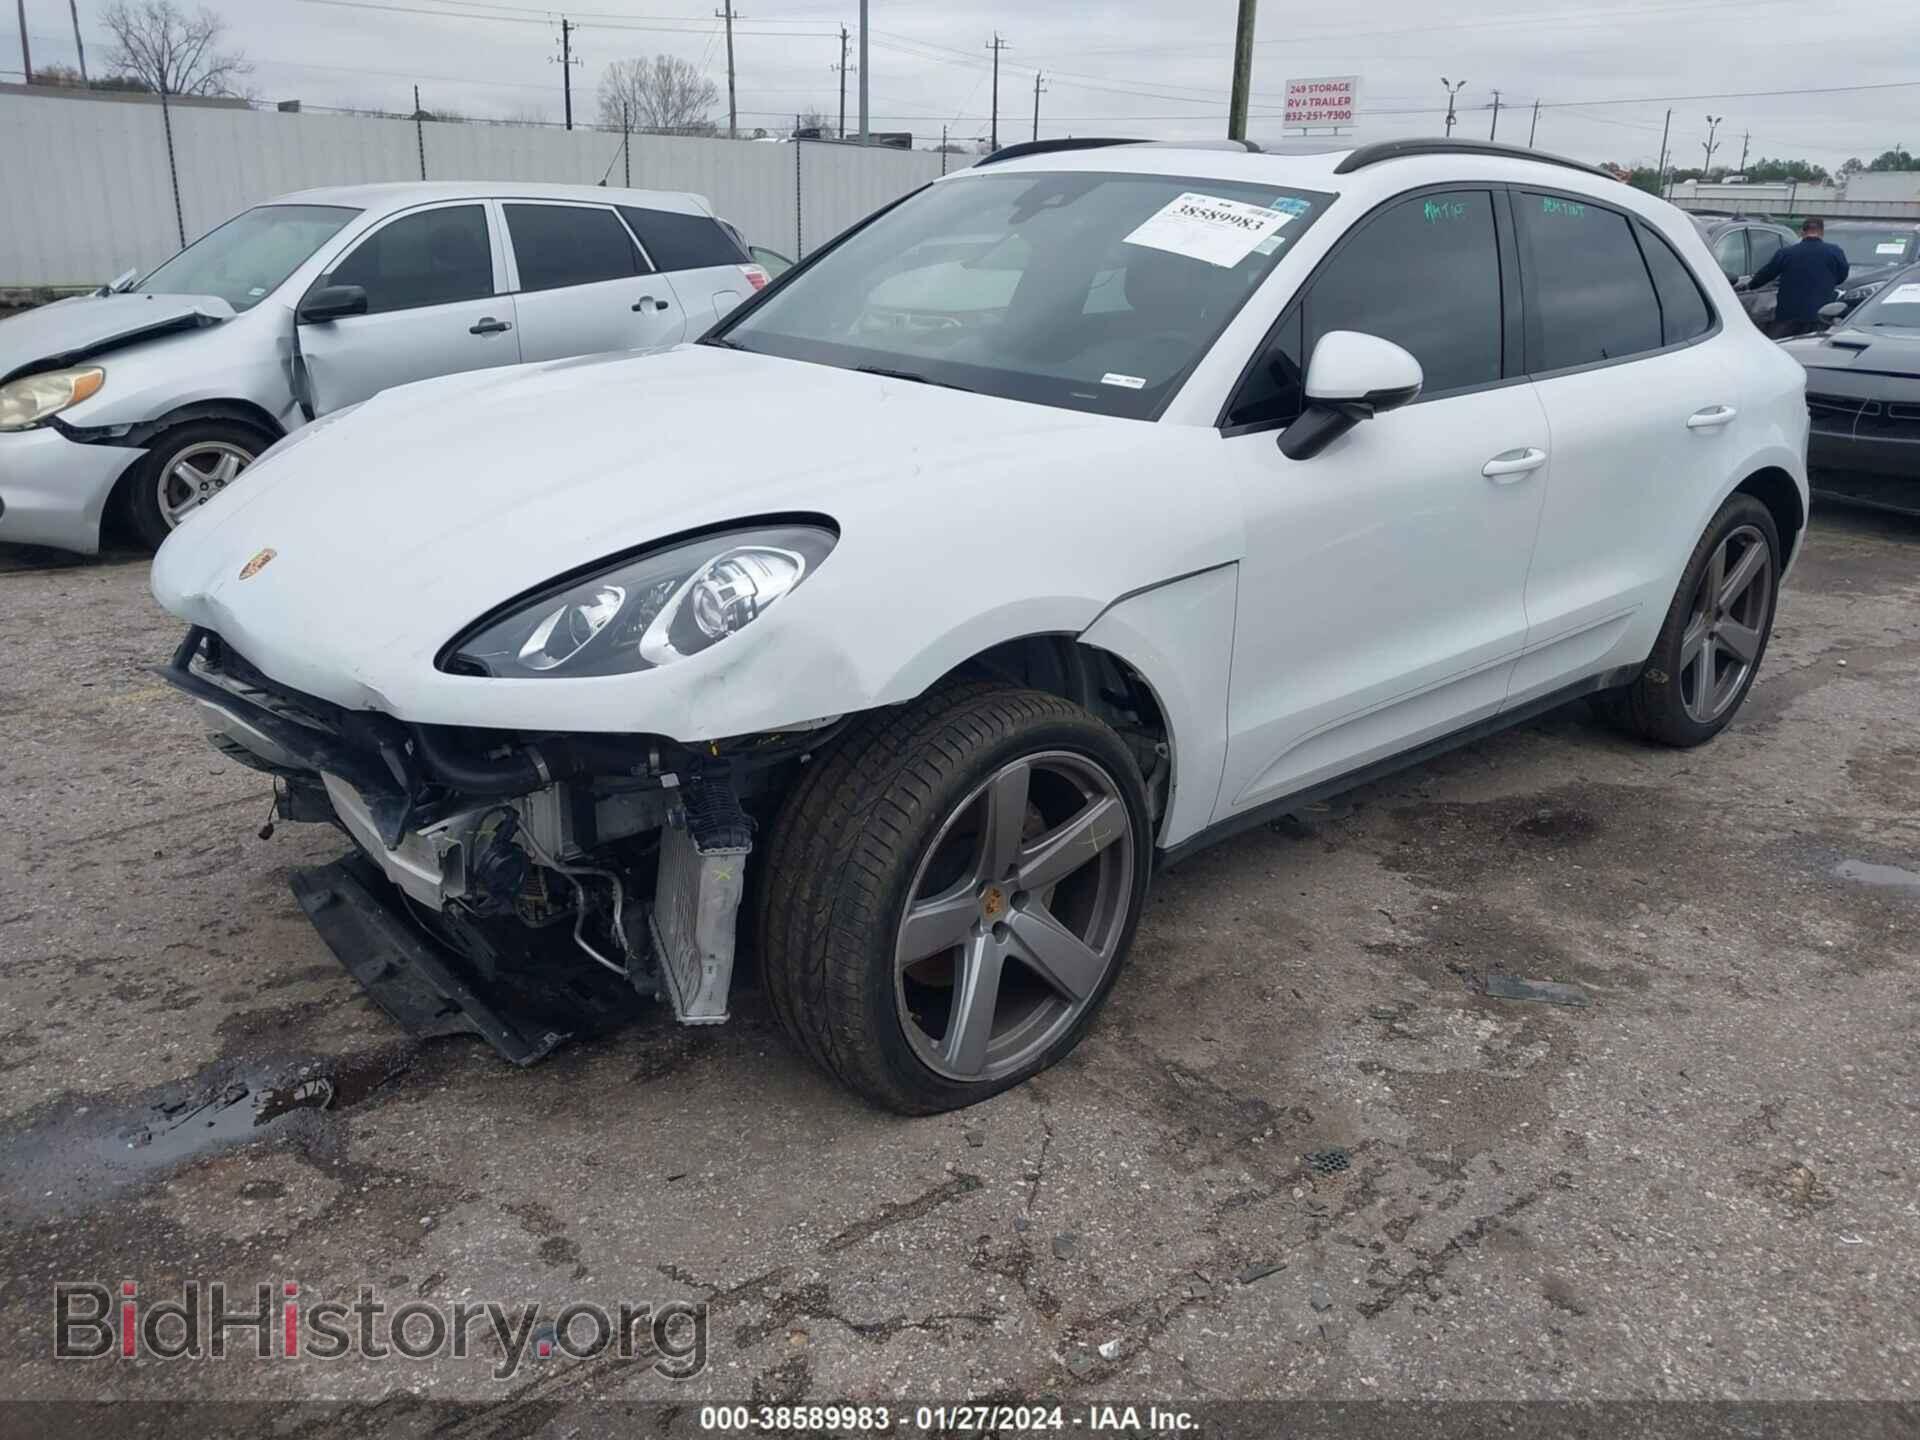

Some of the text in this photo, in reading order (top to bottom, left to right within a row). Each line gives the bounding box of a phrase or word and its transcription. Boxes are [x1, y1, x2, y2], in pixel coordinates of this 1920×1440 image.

[1308, 83, 1351, 93] STORAGE
[1287, 98, 1301, 108] RV
[1309, 97, 1351, 107] TRAILER
[1173, 204, 1264, 230] 38589983
